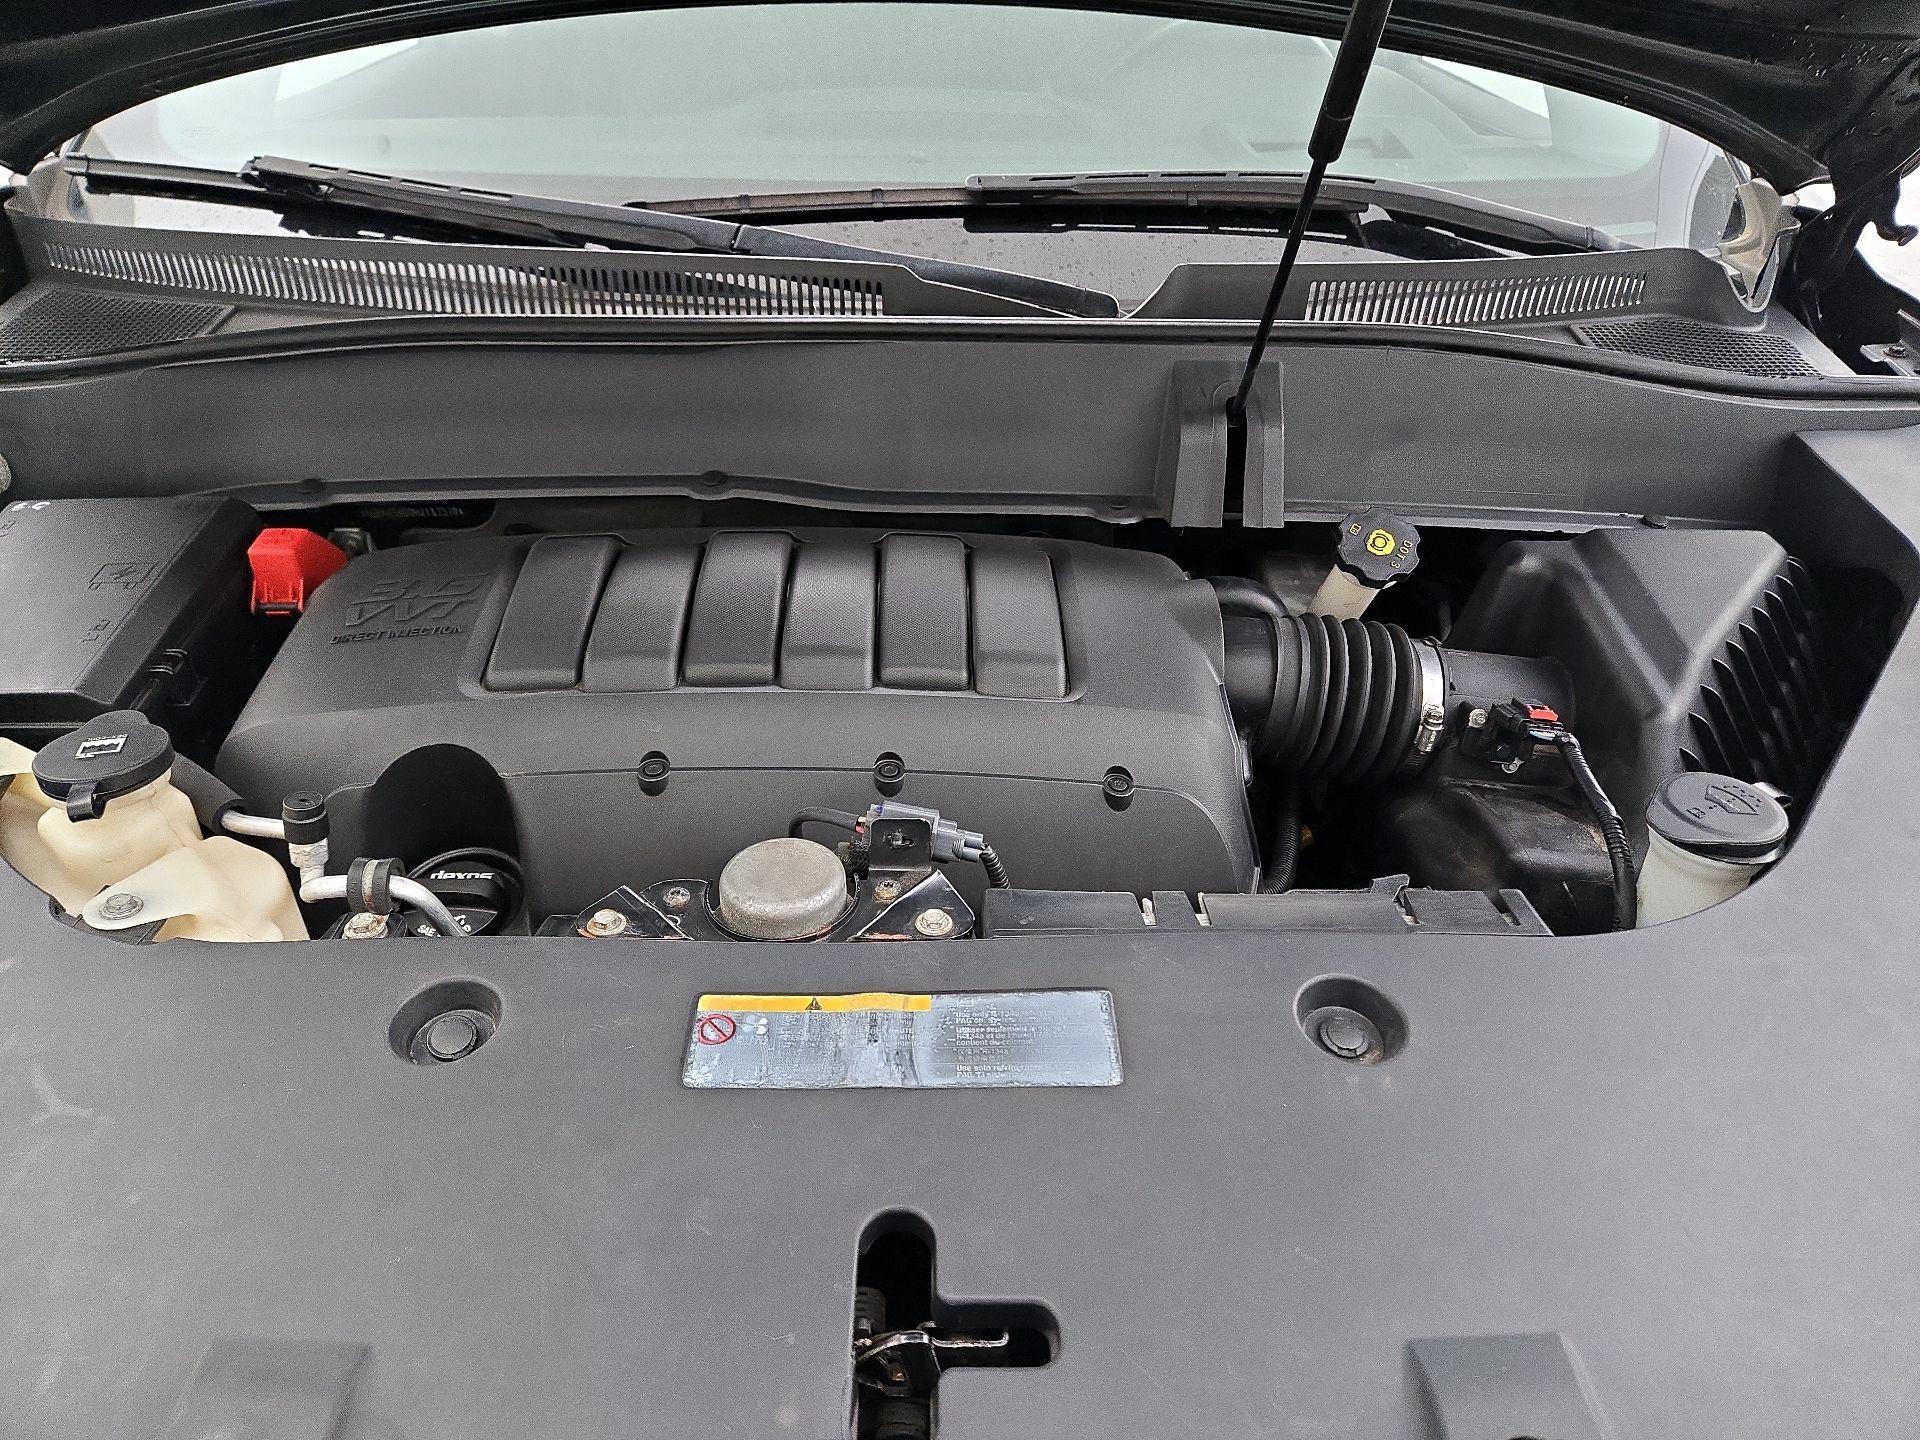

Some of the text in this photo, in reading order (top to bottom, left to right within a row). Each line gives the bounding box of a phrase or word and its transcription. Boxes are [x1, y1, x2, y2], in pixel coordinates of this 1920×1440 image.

[1390, 539, 1414, 569] DOT 3
[346, 597, 478, 627] VVT
[330, 625, 464, 645] DIRECT INJECTION
[417, 924, 436, 938] SAE
